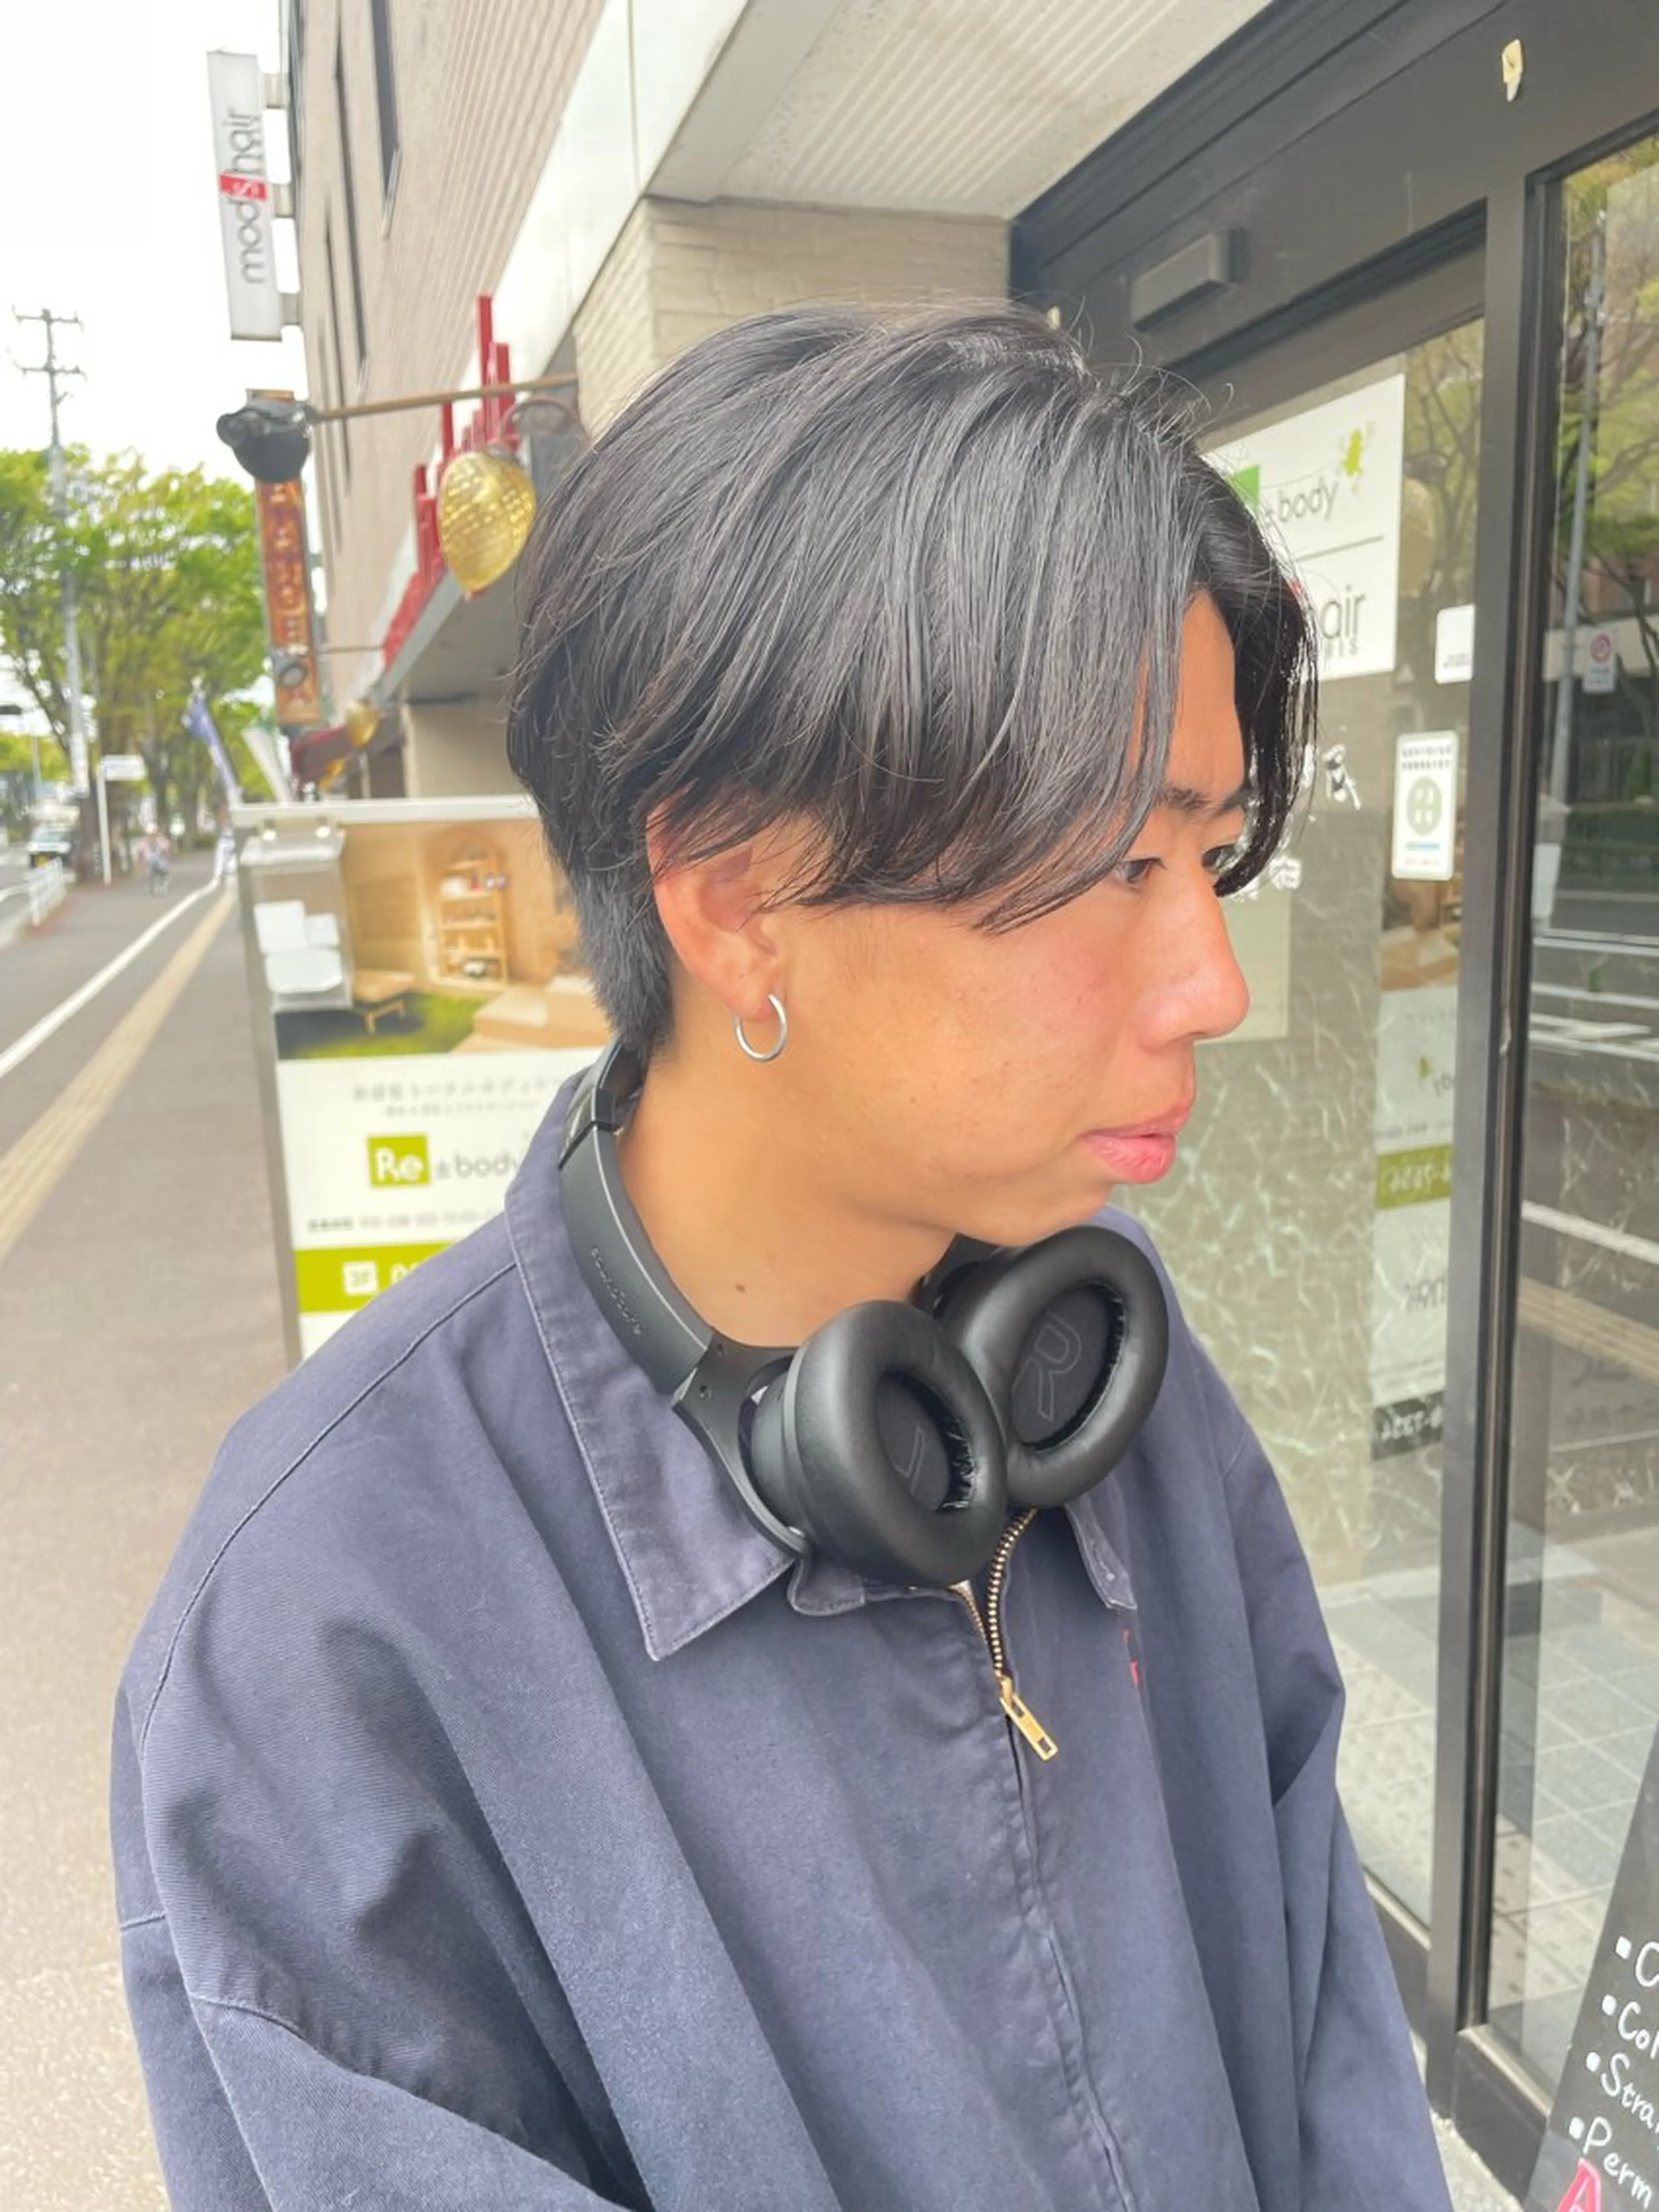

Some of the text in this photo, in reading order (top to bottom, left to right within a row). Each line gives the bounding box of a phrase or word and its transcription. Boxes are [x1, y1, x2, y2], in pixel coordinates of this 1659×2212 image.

[1319, 584, 1366, 640] air
[375, 1147, 424, 1182] Re
[1583, 2117, 1652, 2209] Perm
